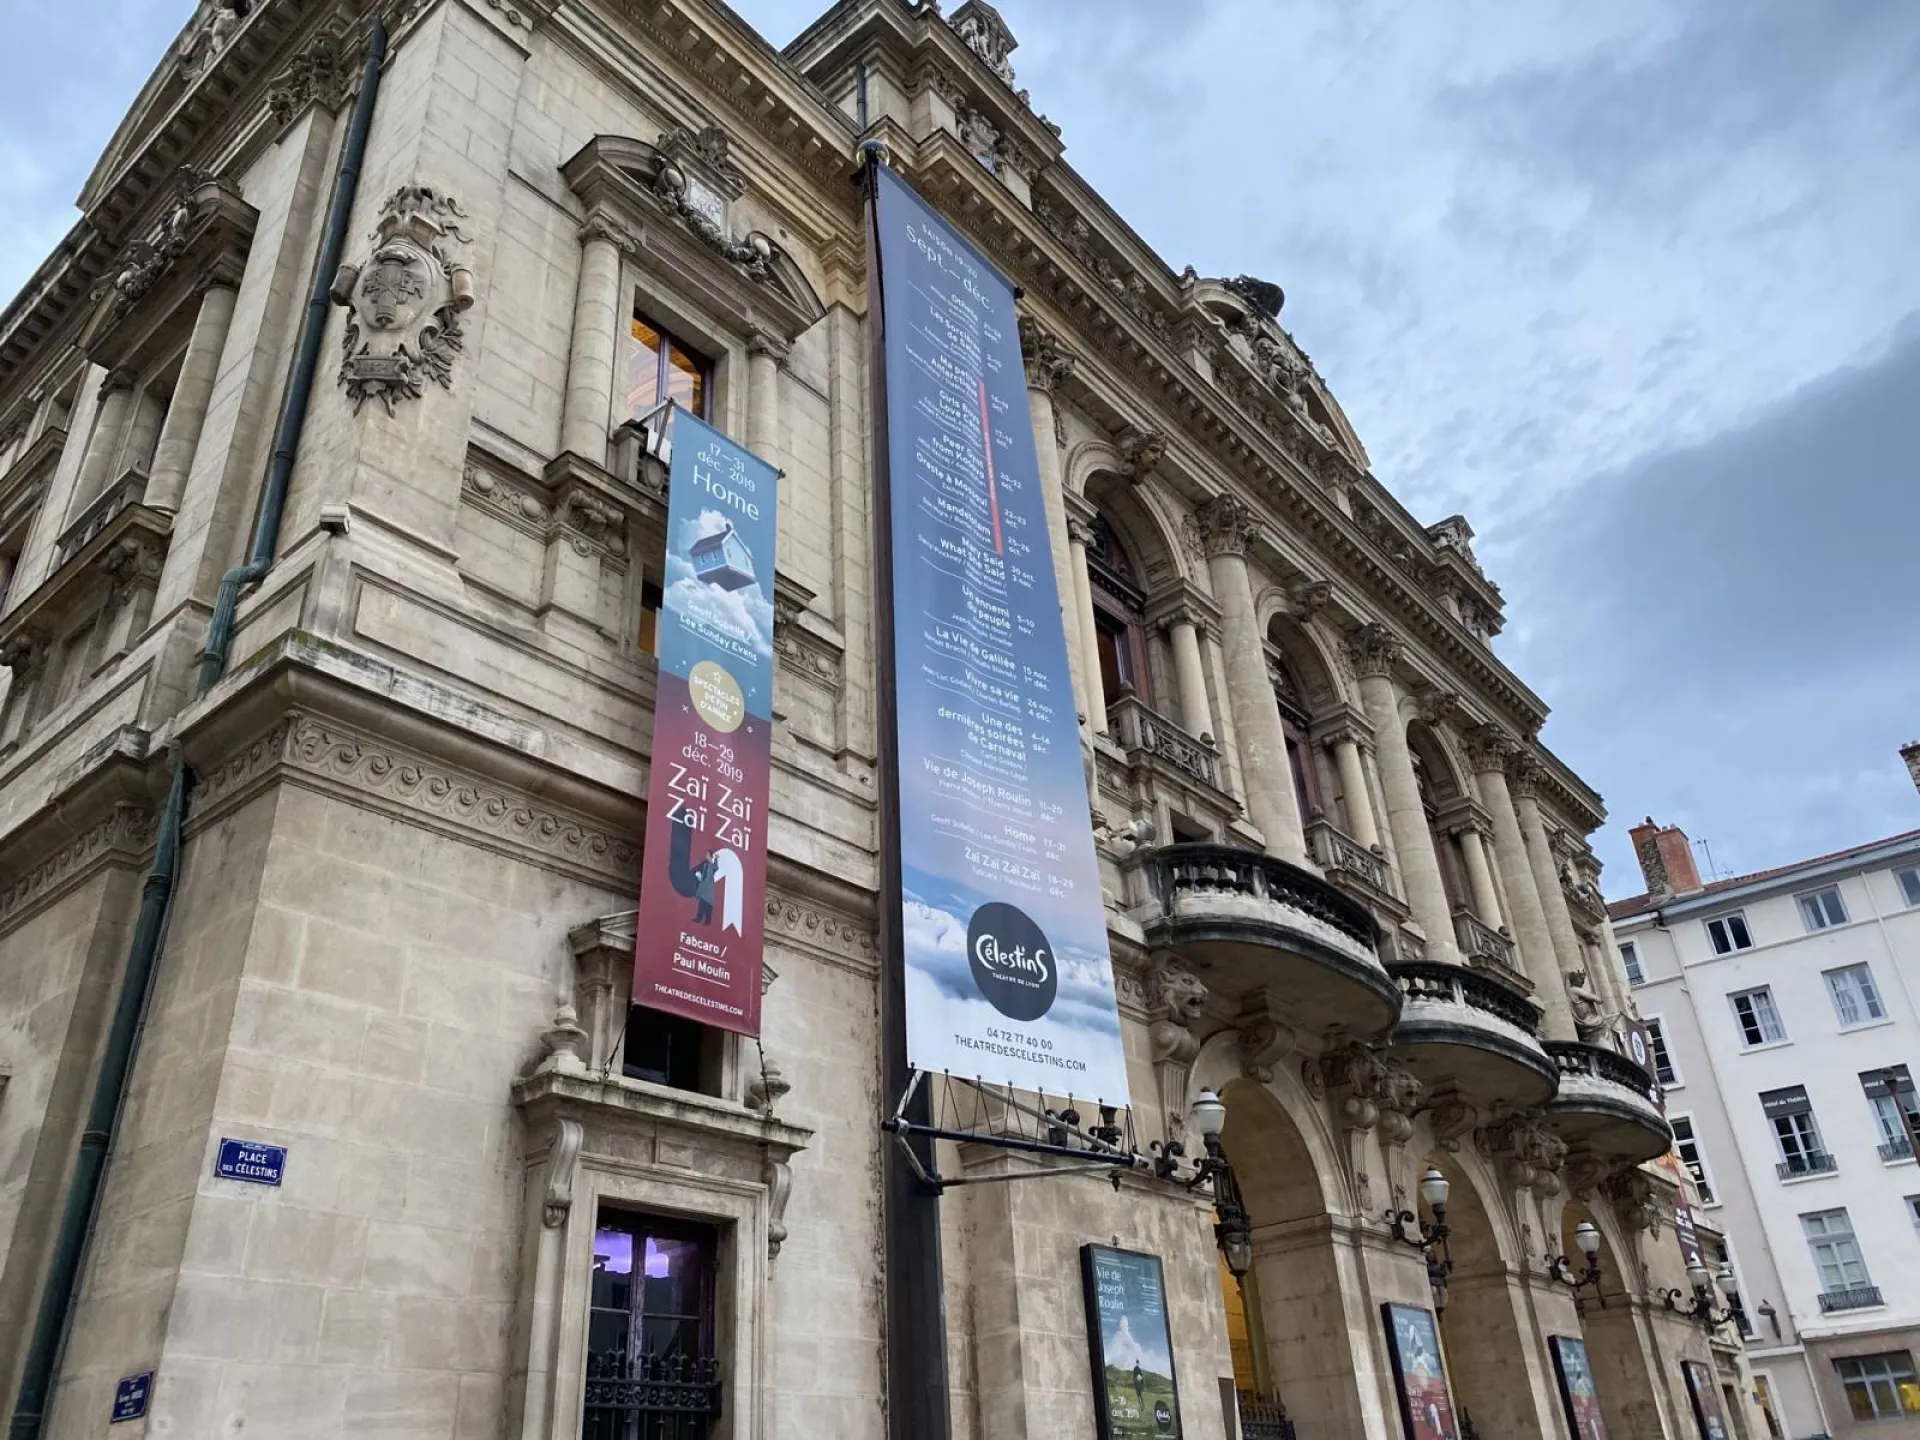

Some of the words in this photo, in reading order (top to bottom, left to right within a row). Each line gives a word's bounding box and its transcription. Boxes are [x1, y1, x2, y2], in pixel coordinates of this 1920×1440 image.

[906, 224, 948, 273] Sept.
[963, 277, 995, 314] déc.
[940, 389, 961, 409] Girls
[940, 399, 961, 419] Love
[932, 437, 954, 457] from
[697, 450, 725, 475] déc.
[728, 467, 756, 493] 2019
[916, 451, 945, 480] Oreste
[692, 464, 760, 521] Home
[940, 537, 967, 557] What
[983, 563, 1006, 581] Said
[962, 536, 981, 559] Mary
[983, 552, 1004, 569] Said
[962, 584, 974, 600] Un
[975, 596, 1010, 619] ennemi
[978, 609, 1011, 630] peuple
[679, 613, 697, 629] Lee
[697, 623, 730, 649] Sunday
[731, 641, 757, 661] Evans
[935, 625, 949, 640] La
[951, 631, 968, 648] Vie
[981, 648, 1016, 671] Galilée
[694, 675, 740, 707] SPECTACLES
[705, 691, 716, 703] DE
[965, 668, 988, 691] Vivre
[990, 685, 1002, 697] sa
[1003, 690, 1020, 703] vie
[937, 706, 985, 735] dernières
[986, 728, 1025, 749] soirées
[981, 711, 1003, 728] Une
[1004, 722, 1023, 737] des
[968, 731, 979, 745] de
[980, 737, 1026, 762] Carnaval
[682, 744, 712, 768] déc.
[716, 758, 744, 783] 2019
[667, 761, 710, 801] Zaï
[717, 783, 754, 822] Zaï
[923, 756, 941, 775] Vie
[943, 767, 959, 780] de
[961, 771, 996, 796] Joseph
[997, 786, 1033, 808] Roulin
[665, 792, 708, 832] Zaï
[714, 813, 752, 851] Zaï
[1003, 824, 1037, 845] Home
[680, 930, 720, 955] Fabcaro
[673, 952, 696, 970] Paul
[697, 959, 731, 981] Moulin
[654, 983, 744, 1017] THEATREDESCELESTINS.COM
[1025, 980, 1040, 989] LYON
[954, 1034, 1087, 1072] THEATREDESCELESTINS.COM
[987, 1026, 999, 1039] 04
[1000, 1030, 1013, 1043] 72
[1014, 1033, 1025, 1045] 77
[1026, 1036, 1039, 1048] 40
[1040, 1039, 1053, 1051] 00
[222, 1164, 233, 1172] DES
[235, 1163, 278, 1179] CÉLESTINS
[238, 1151, 268, 1164] PLACE
[1095, 1265, 1110, 1280] Vie
[1111, 1270, 1122, 1281] de
[1098, 1280, 1124, 1297] Joseph
[1098, 1295, 1124, 1311] Roulin
